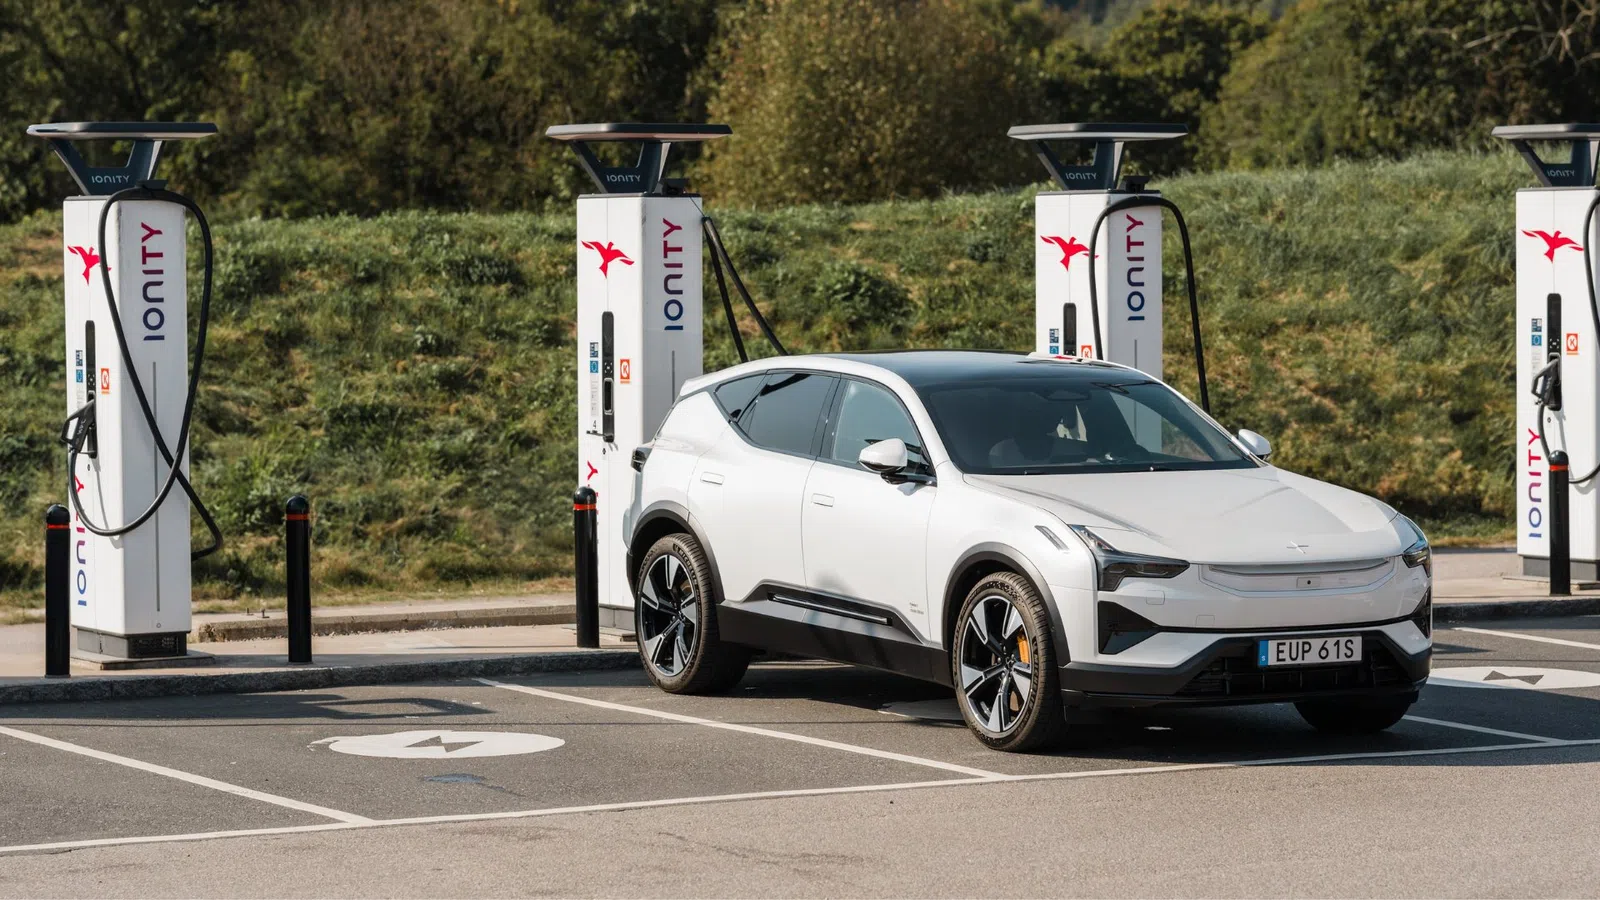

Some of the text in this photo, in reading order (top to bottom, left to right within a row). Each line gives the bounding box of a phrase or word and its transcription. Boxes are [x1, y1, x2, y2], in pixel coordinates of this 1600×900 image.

[91, 174, 130, 184] IONITY
[606, 174, 641, 183] IONITY
[1065, 172, 1097, 180] IONITY
[1547, 169, 1575, 177] IONITY
[140, 221, 165, 341] IONITY
[662, 217, 684, 331] IONITY
[1125, 213, 1145, 321] IONITY
[1528, 427, 1542, 538] IONITY
[74, 474, 88, 607] IONIY
[1276, 639, 1354, 662] EUP 61S
